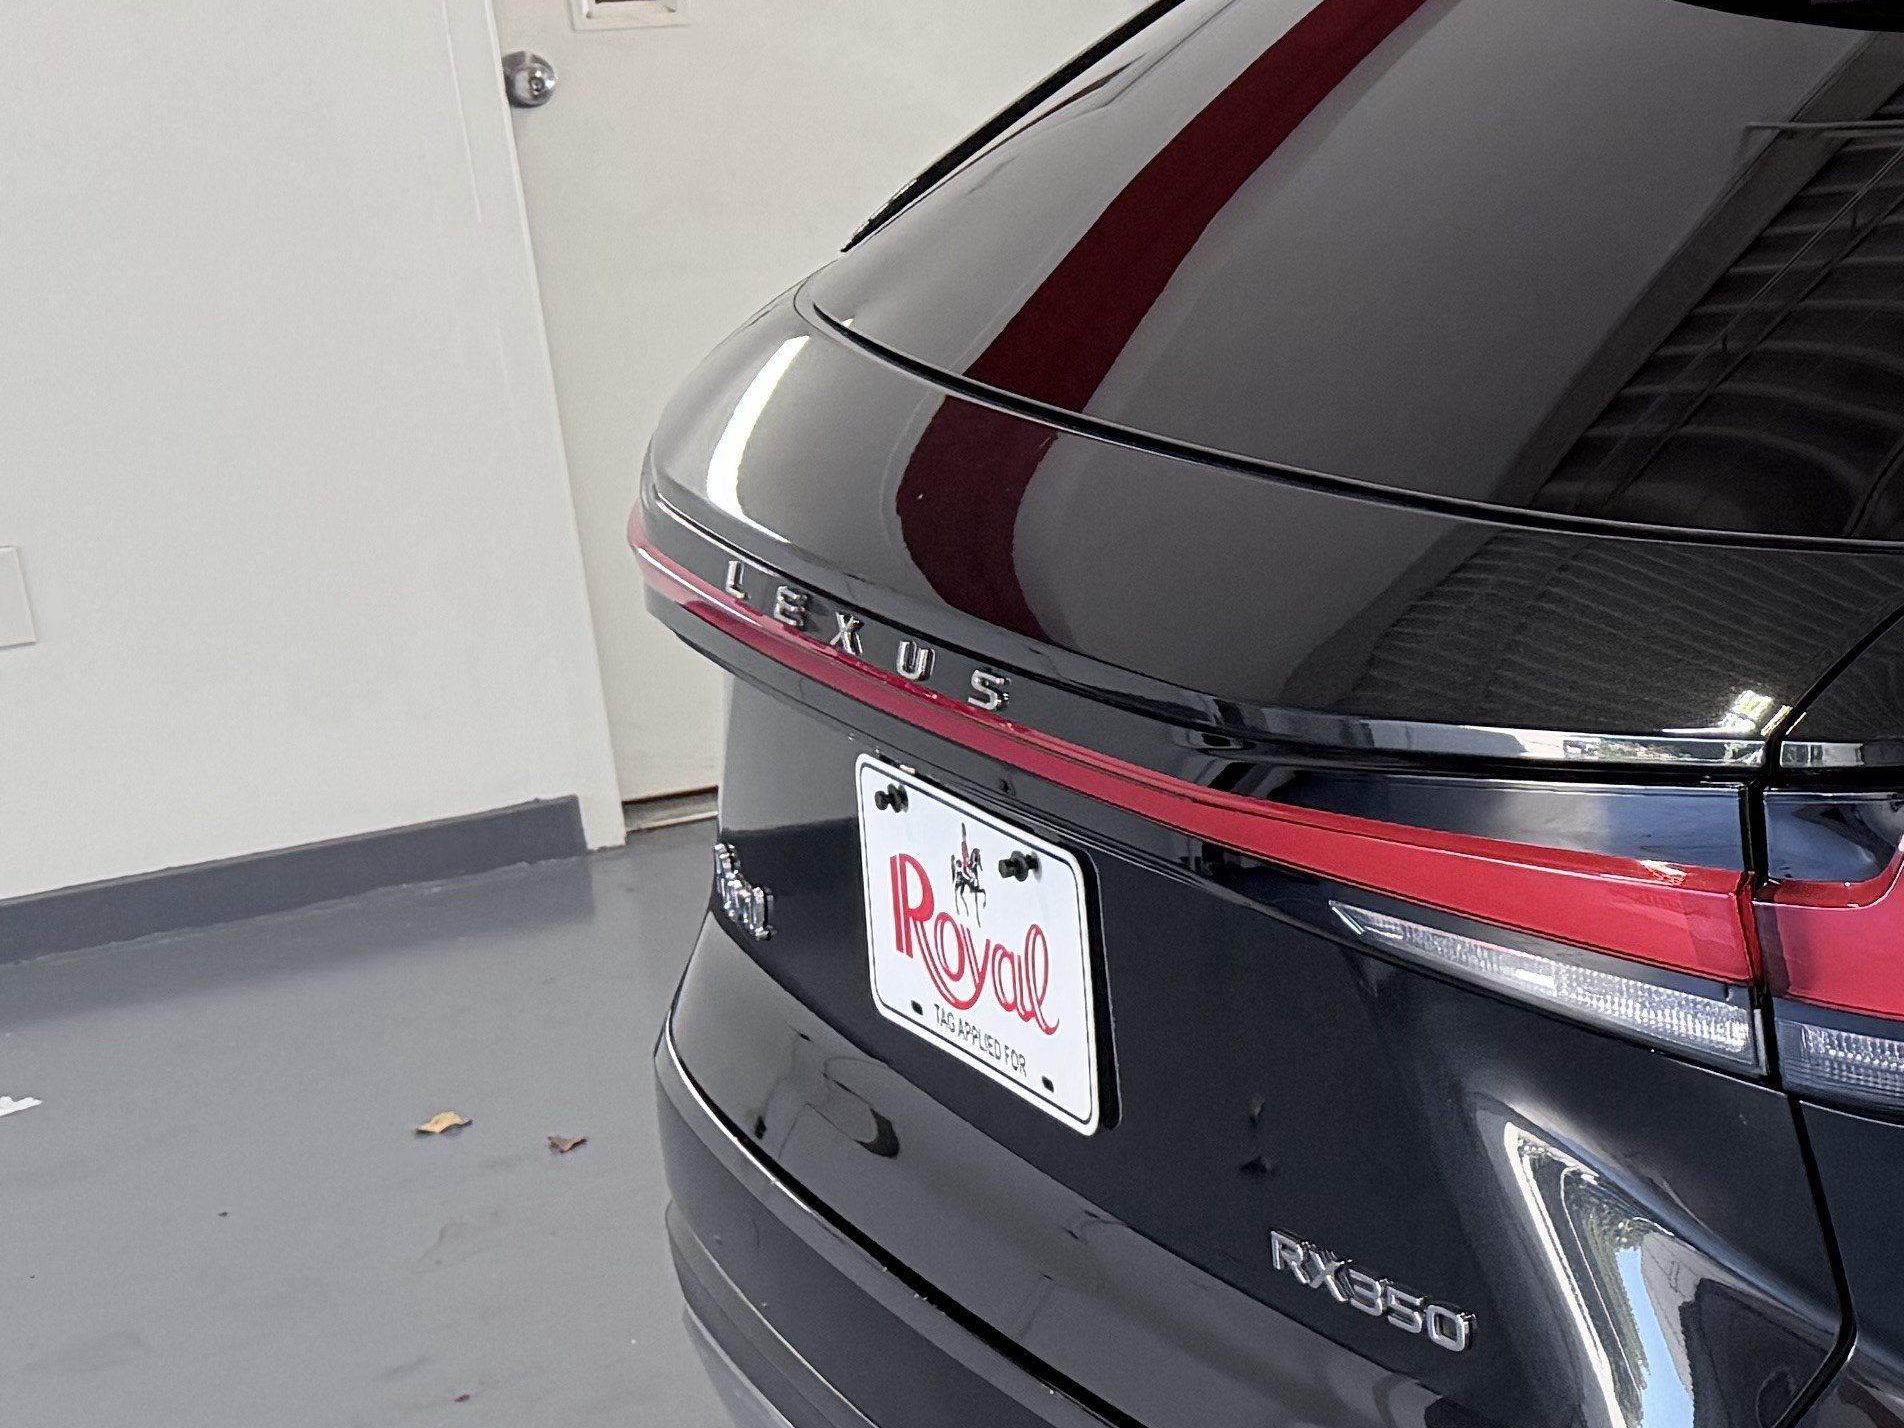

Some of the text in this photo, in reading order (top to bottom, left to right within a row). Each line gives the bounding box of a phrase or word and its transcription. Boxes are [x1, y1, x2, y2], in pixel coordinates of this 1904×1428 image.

[725, 560, 1012, 711] LEXUS
[889, 852, 1060, 1036] Royal
[934, 1003, 1028, 1077] TAG APPLIED FOR
